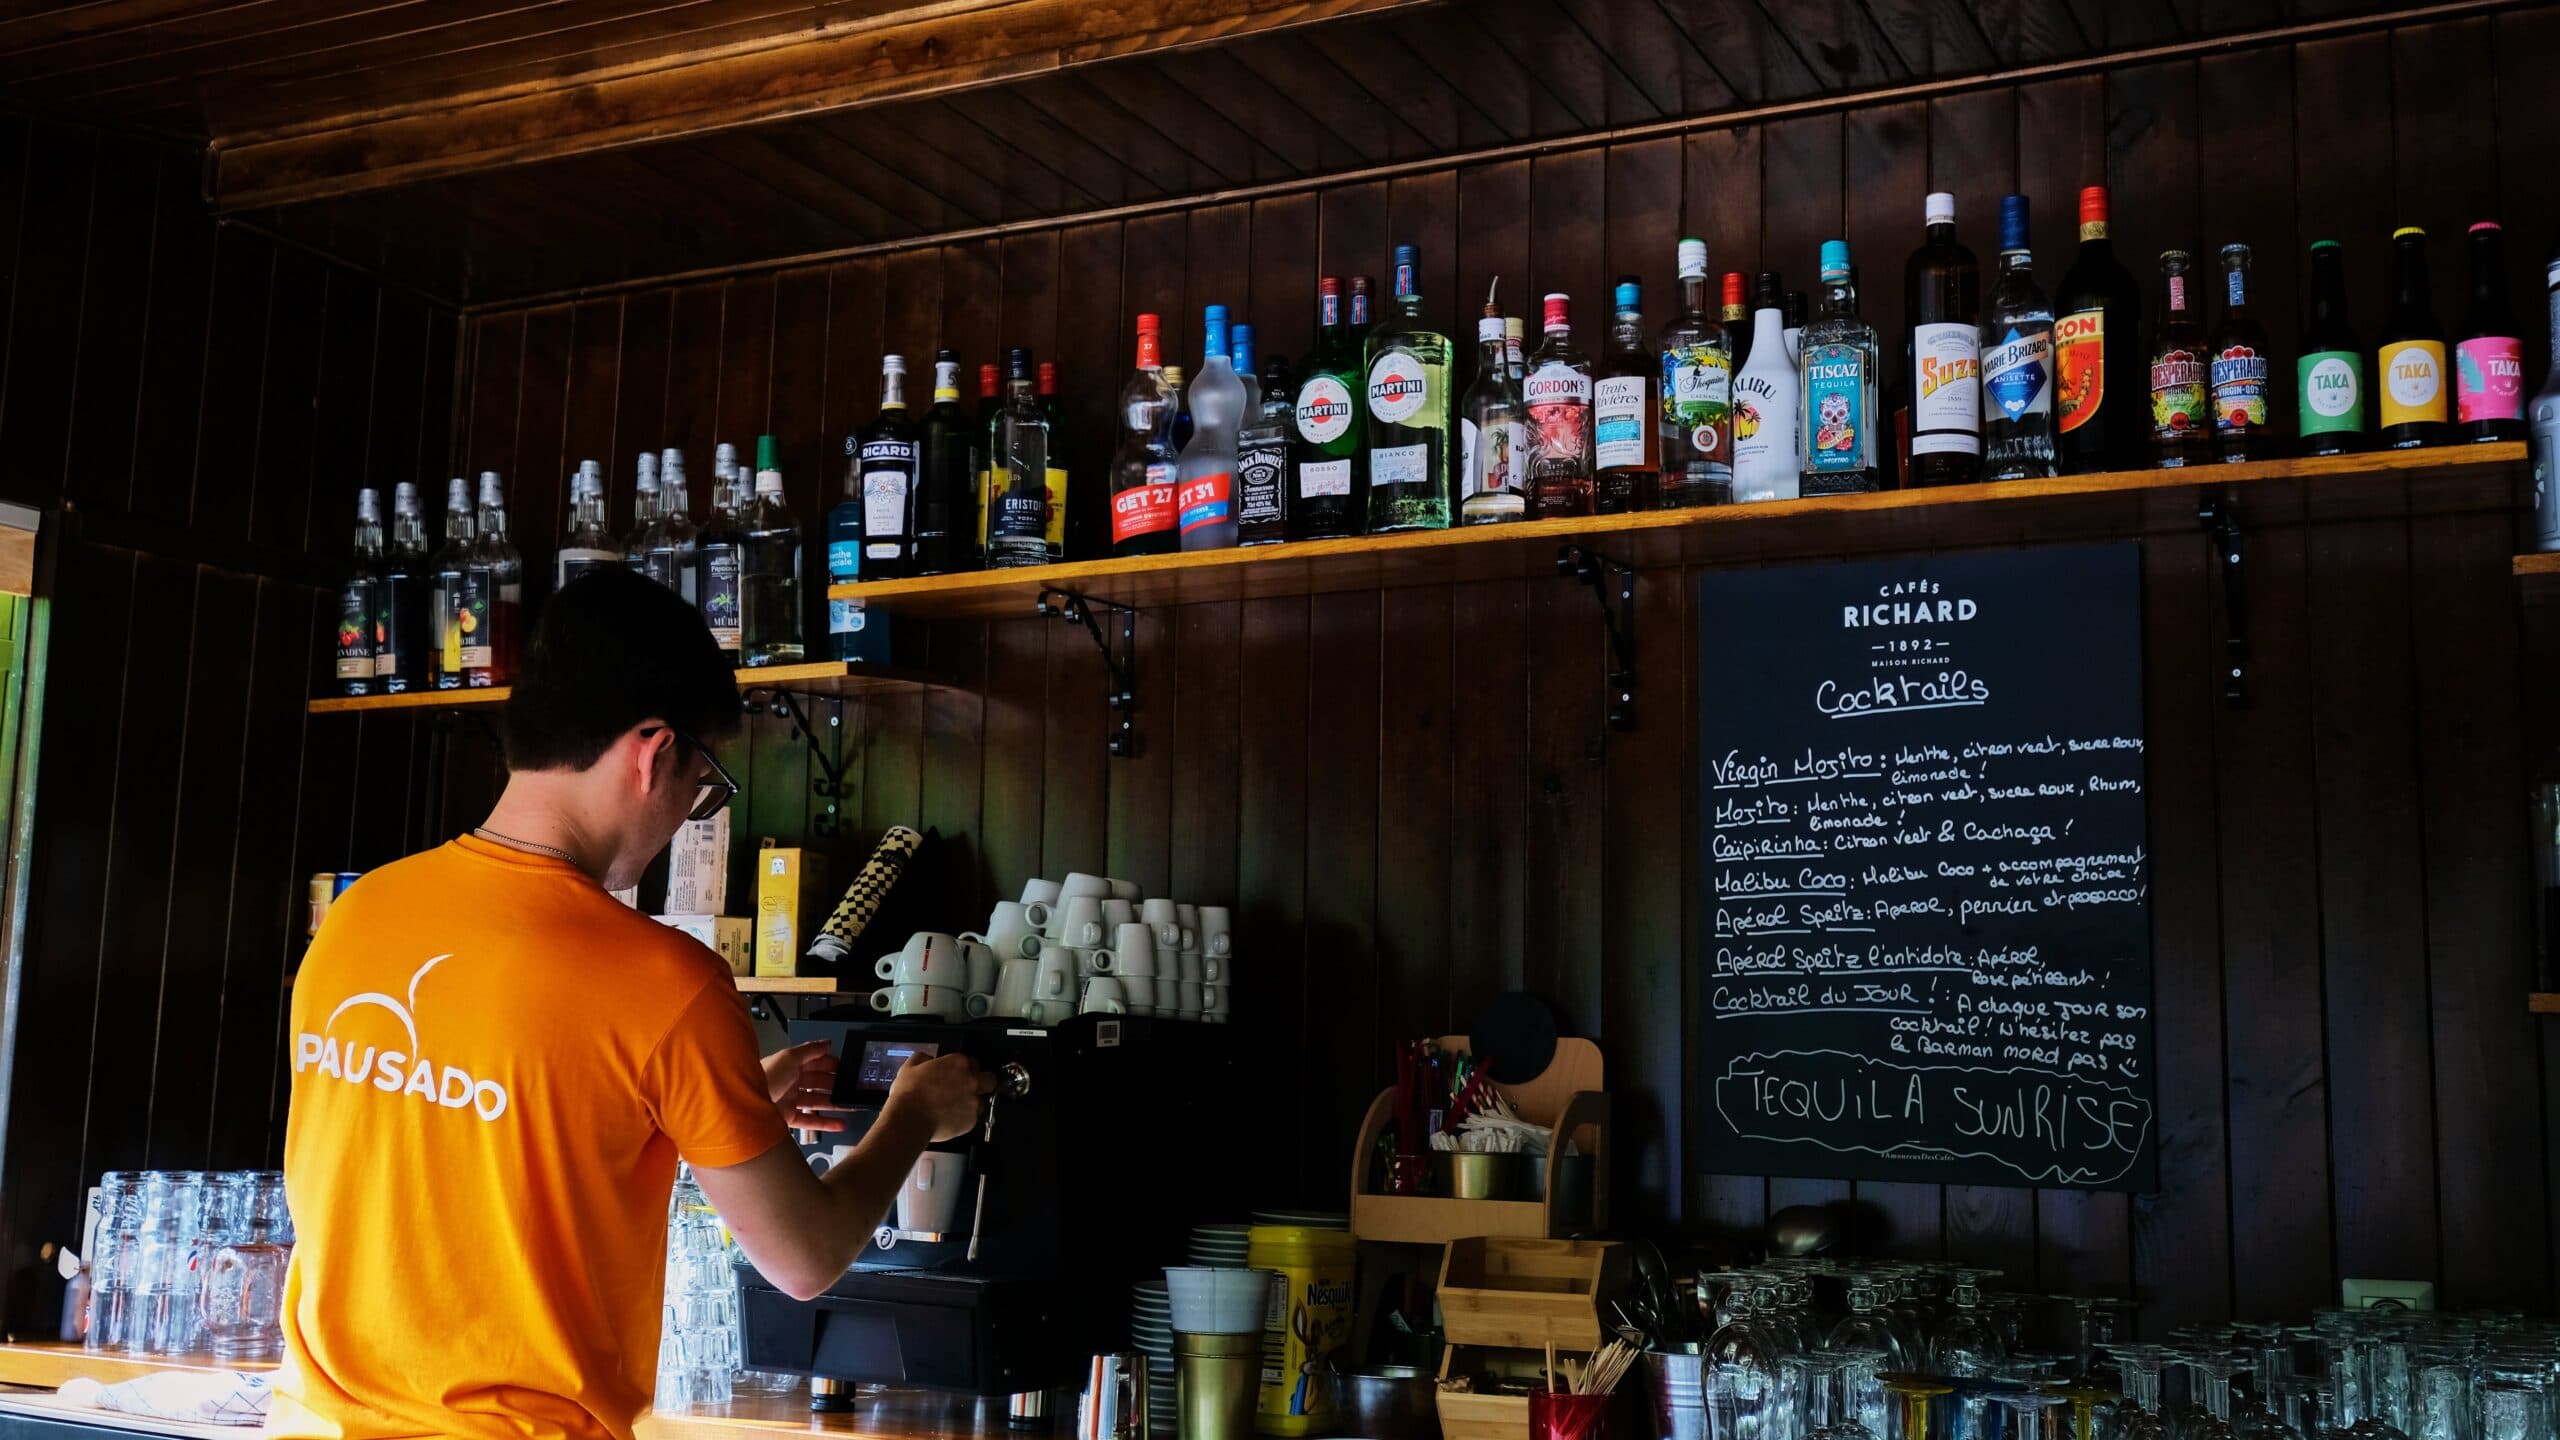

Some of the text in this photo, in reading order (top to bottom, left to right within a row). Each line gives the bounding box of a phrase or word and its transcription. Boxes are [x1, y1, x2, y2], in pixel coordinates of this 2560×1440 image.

[2056, 316, 2097, 341] CON
[1984, 338, 2047, 376] MARIE BRIZARD
[1809, 362, 1859, 380] TISCAZ
[1994, 373, 2036, 383] ANISETTE
[2395, 363, 2432, 380] TAKA
[2487, 360, 2521, 377] TAKA
[1371, 380, 1422, 399] MARTINI
[1528, 378, 1585, 396] GORDON'S
[1600, 382, 1629, 397] Trois
[1815, 380, 1855, 389] TEQUILA
[2314, 373, 2349, 391] TAKA
[1300, 403, 1348, 419] MARTINI
[862, 445, 911, 458] RICARD
[1379, 450, 1415, 459] BIANCO
[1238, 455, 1254, 473] JACK
[1116, 487, 1173, 513] GET 27
[1179, 481, 1215, 511] ET 31
[1880, 579, 1940, 597] CAFÉS
[1844, 599, 1977, 628] RICHARD
[1889, 639, 1932, 652] 1892
[1871, 657, 1950, 667] MAISON RICHARD
[1816, 671, 1989, 714] Cocktails
[1713, 750, 1778, 787] Virgin
[1963, 742, 2013, 758] citron
[1892, 766, 1971, 785] limonade
[1883, 791, 1933, 806] citron
[1809, 813, 1888, 832] limonade
[1938, 819, 1956, 843] &
[1963, 822, 2056, 845] Cachaça
[1715, 868, 1790, 893] Malibu
[1862, 863, 1928, 886] Malibu
[1938, 861, 1975, 877] Coco
[1990, 875, 2010, 888] de
[1716, 904, 1790, 935] Apérol
[1960, 897, 2038, 925] perrier
[1717, 944, 1786, 976] Apérol
[1793, 943, 1862, 973] Spritz
[1713, 984, 1811, 1010] Cocktail
[1820, 986, 1847, 1004] du
[1978, 997, 2050, 1019] chaque
[2116, 1005, 2147, 1019] son
[2000, 1015, 2091, 1043] N'hésitez
[2100, 1033, 2136, 1050] pas
[2068, 1052, 2108, 1072] pas
[296, 1032, 508, 1122] PAUSADO
